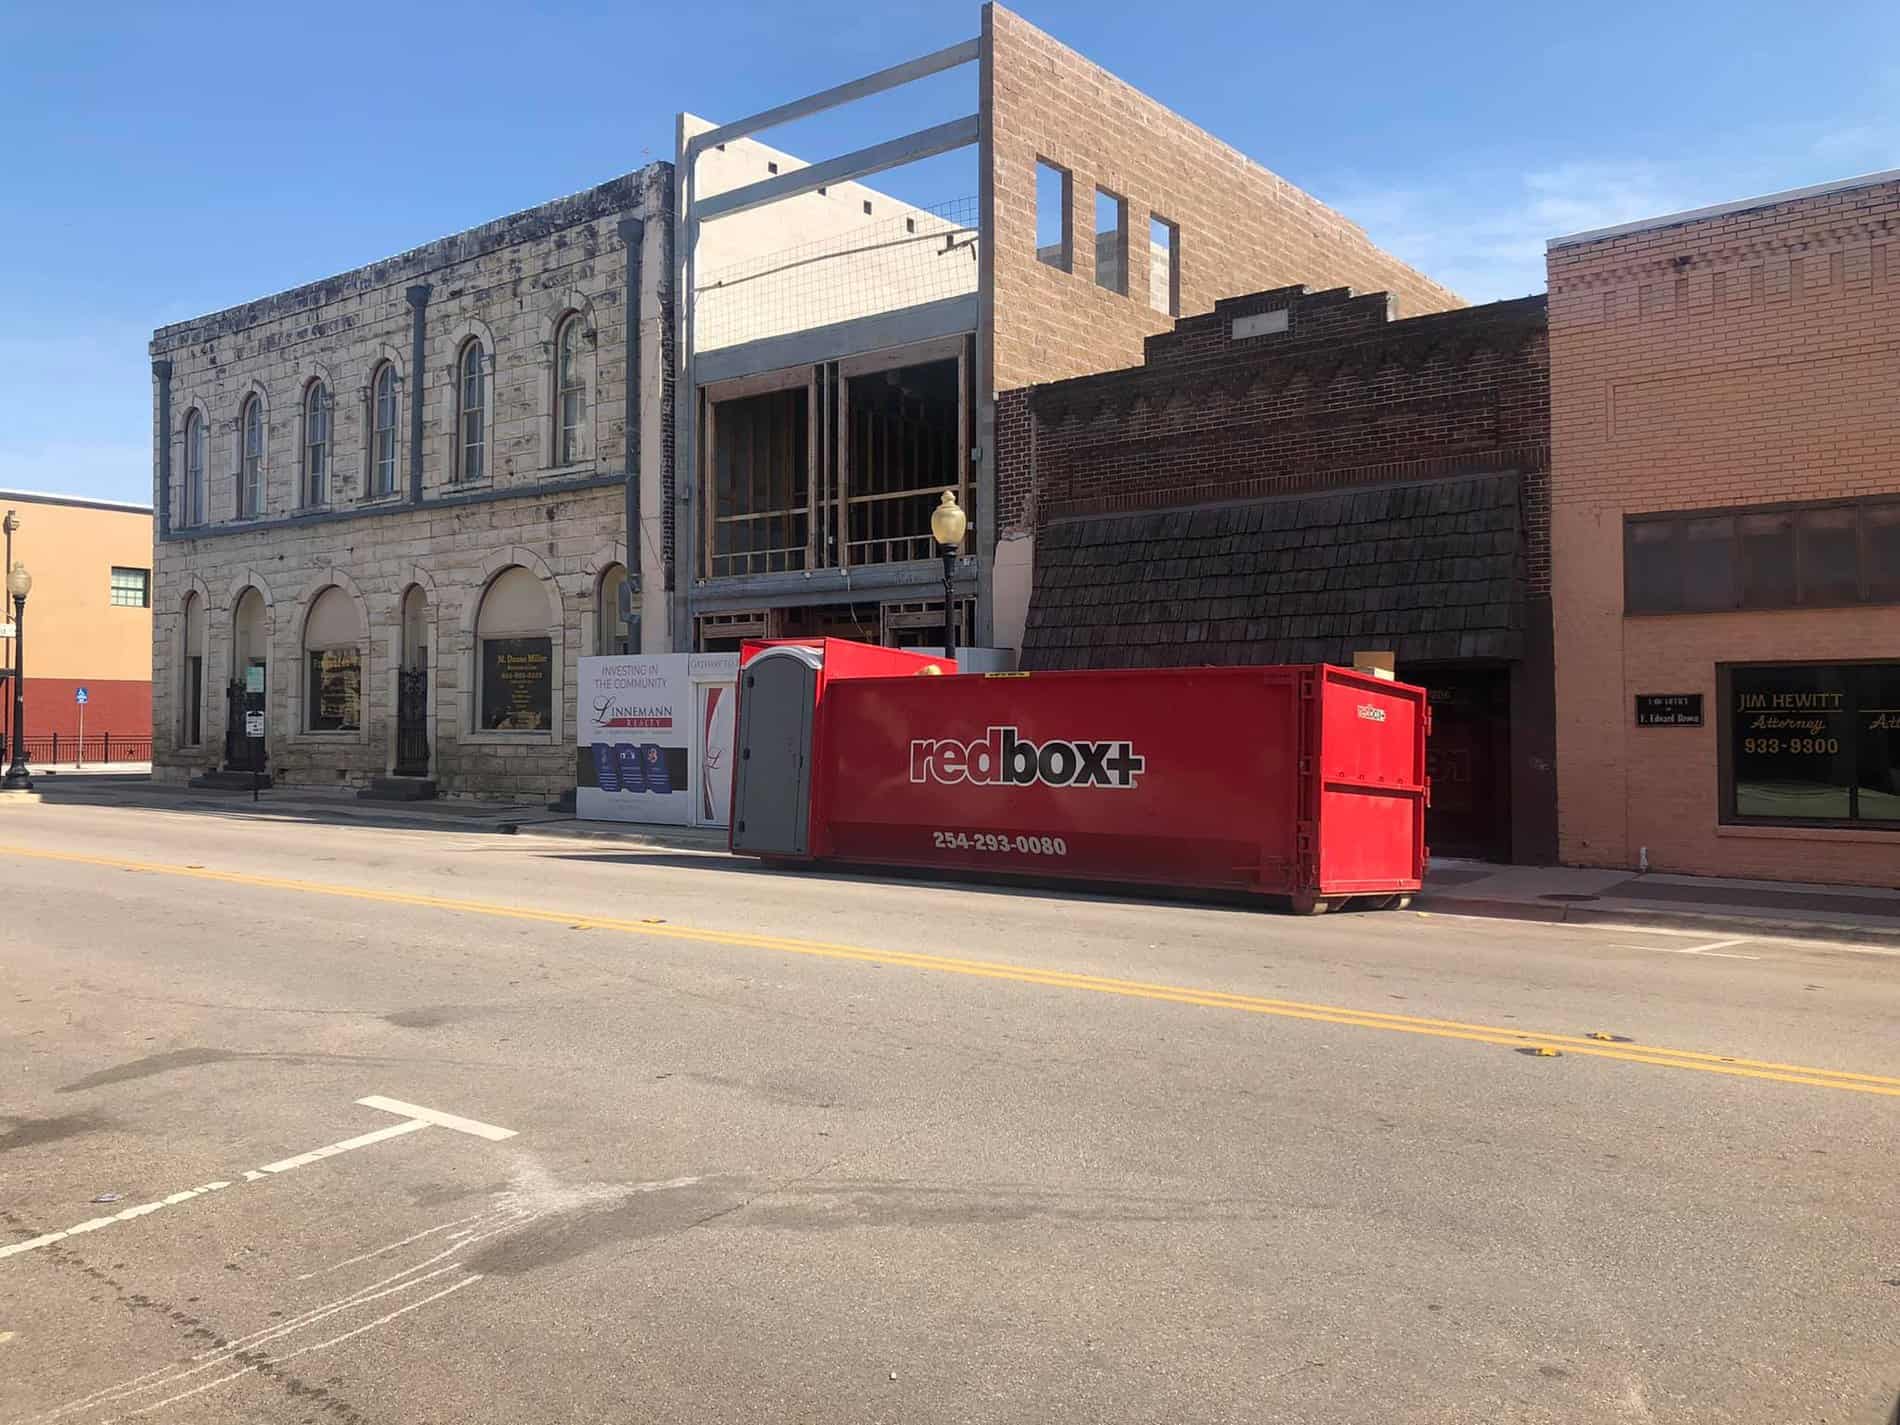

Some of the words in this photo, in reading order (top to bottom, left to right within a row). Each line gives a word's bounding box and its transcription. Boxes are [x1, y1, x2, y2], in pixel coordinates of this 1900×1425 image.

[602, 665, 646, 676] INVESTING
[649, 664, 659, 674] IN
[595, 679, 613, 689] THE
[614, 678, 668, 690] COMMUNITY
[1738, 694, 1766, 711] JIM
[1772, 694, 1844, 709] HEWITT
[1751, 714, 1826, 735] Attorney
[1744, 738, 1839, 754] 933-9300
[933, 832, 1067, 855] 254-293-0080
